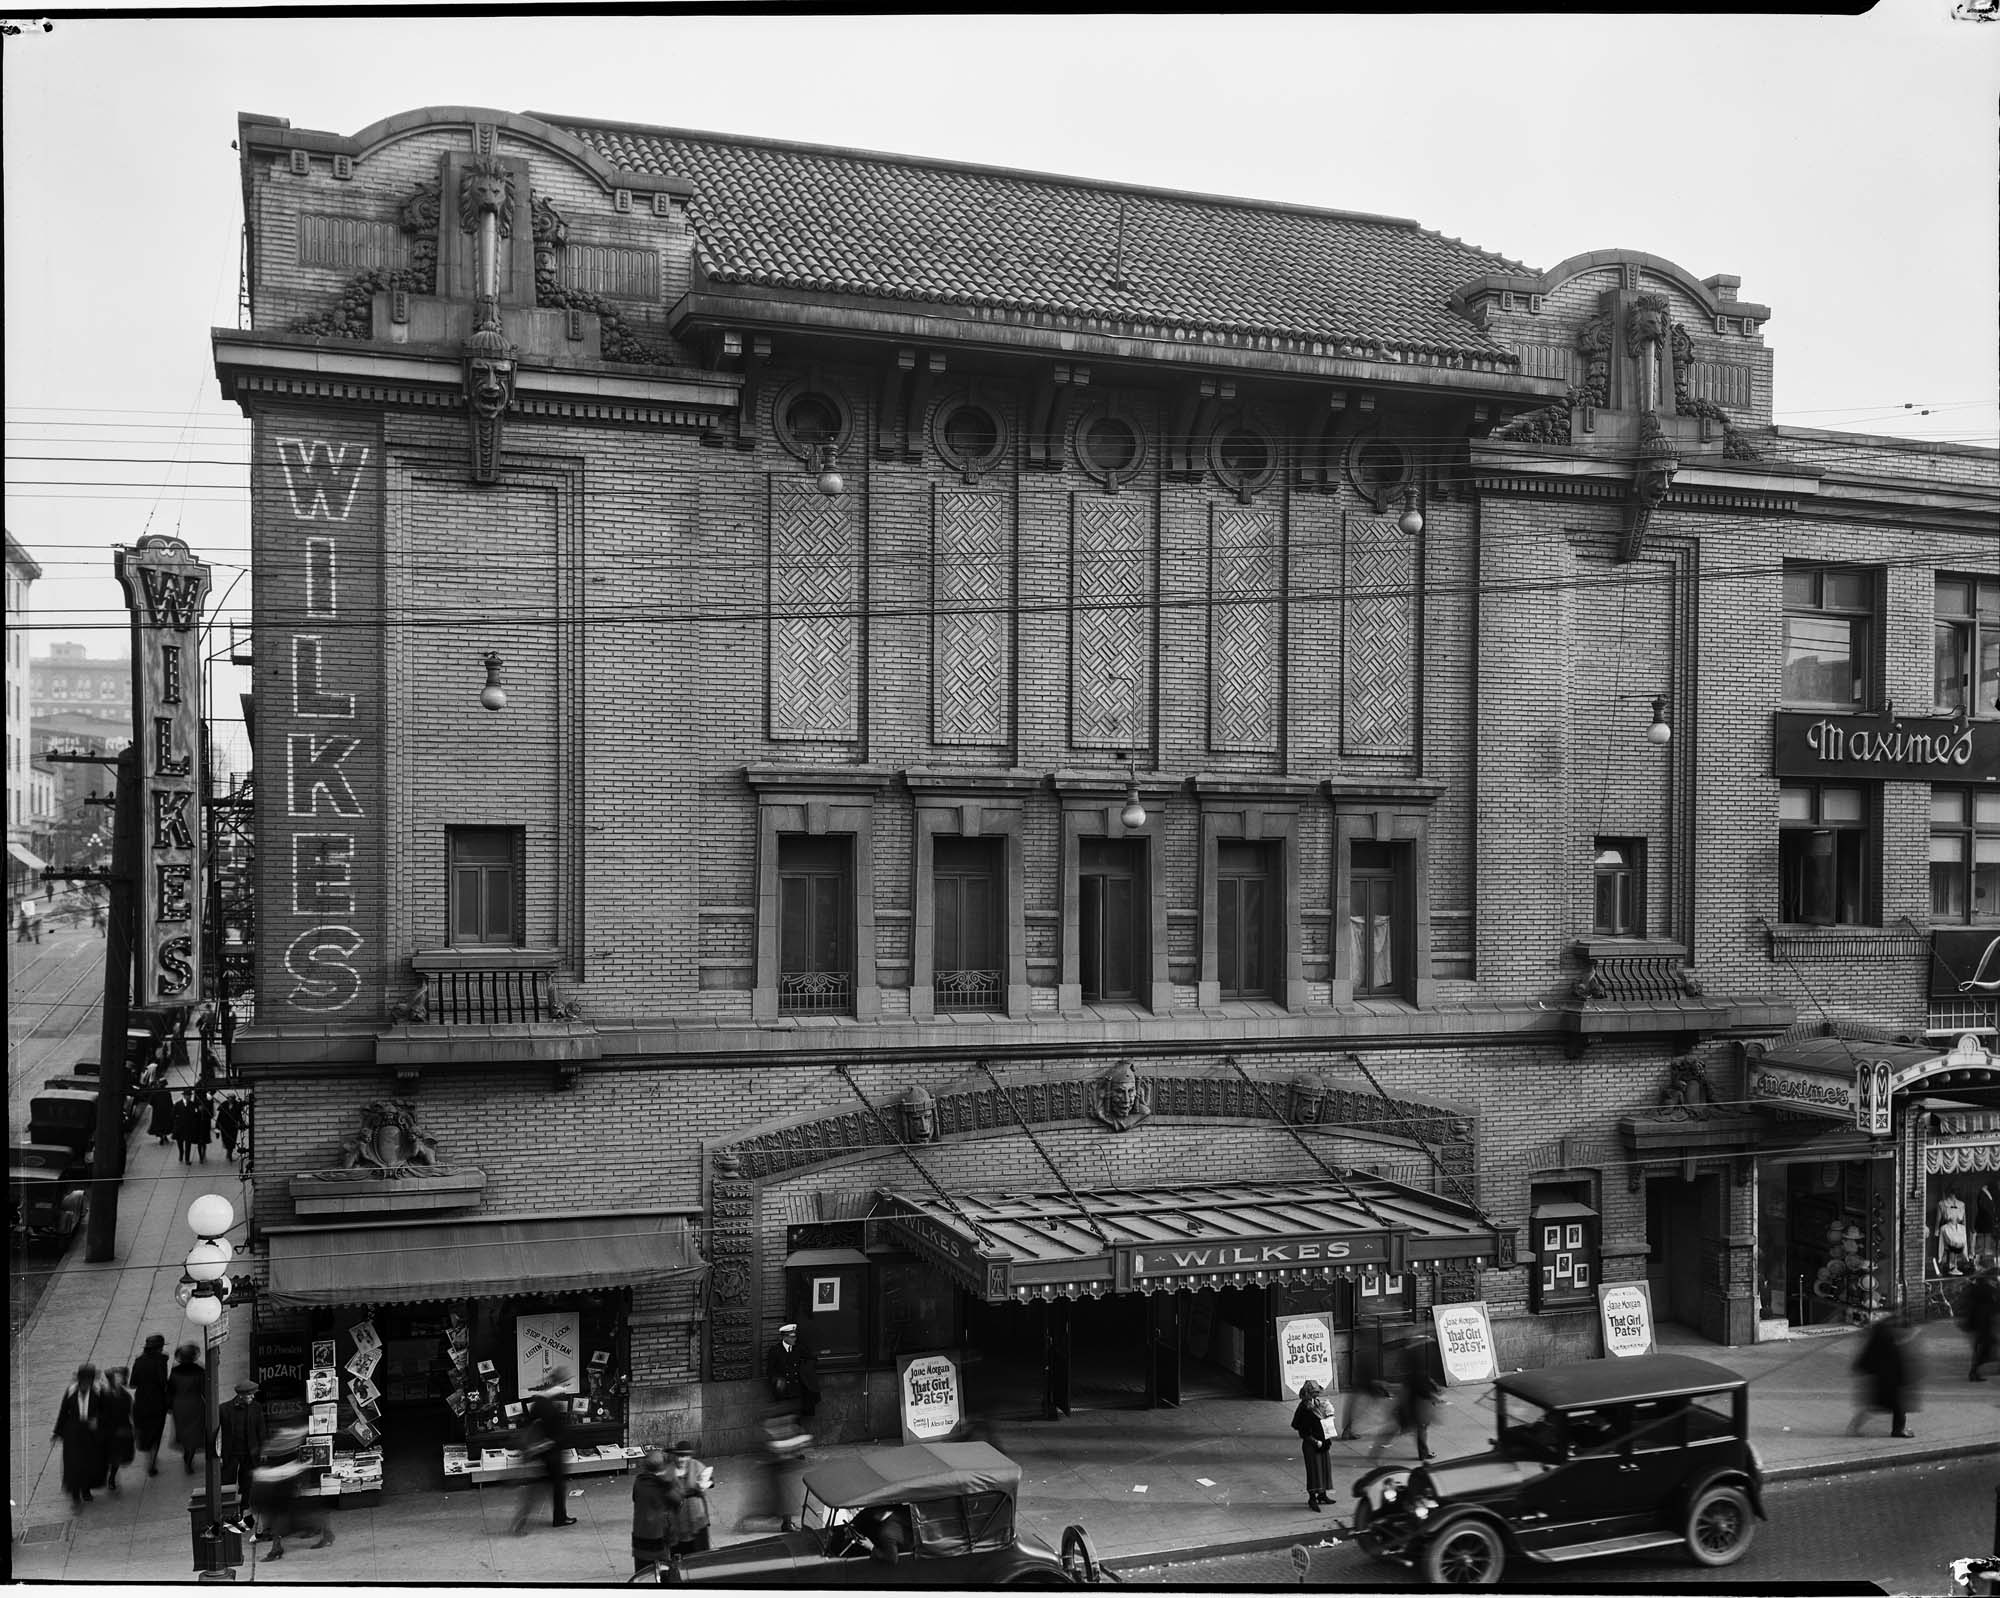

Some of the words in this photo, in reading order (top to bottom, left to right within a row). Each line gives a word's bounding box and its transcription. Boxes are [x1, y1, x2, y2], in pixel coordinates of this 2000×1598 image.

[275, 436, 370, 1013] WILKES
[1806, 719, 1976, 766] Maxime's
[139, 566, 201, 995] WILKES
[1757, 1074, 1849, 1105] Maxime's
[904, 1210, 960, 1258] WILKES
[1171, 1241, 1352, 1268] WILKES
[1608, 1313, 1625, 1327] That
[525, 1328, 541, 1339] STOP
[554, 1325, 570, 1338] LOOK
[1446, 1329, 1464, 1341] That
[1614, 1325, 1641, 1336] Patsy
[525, 1343, 542, 1358] LISTEN
[1287, 1343, 1305, 1354] That
[258, 1363, 304, 1384] MOZART
[909, 1368, 925, 1380] Jane
[927, 1365, 950, 1375] Morgan
[910, 1380, 931, 1394] That
